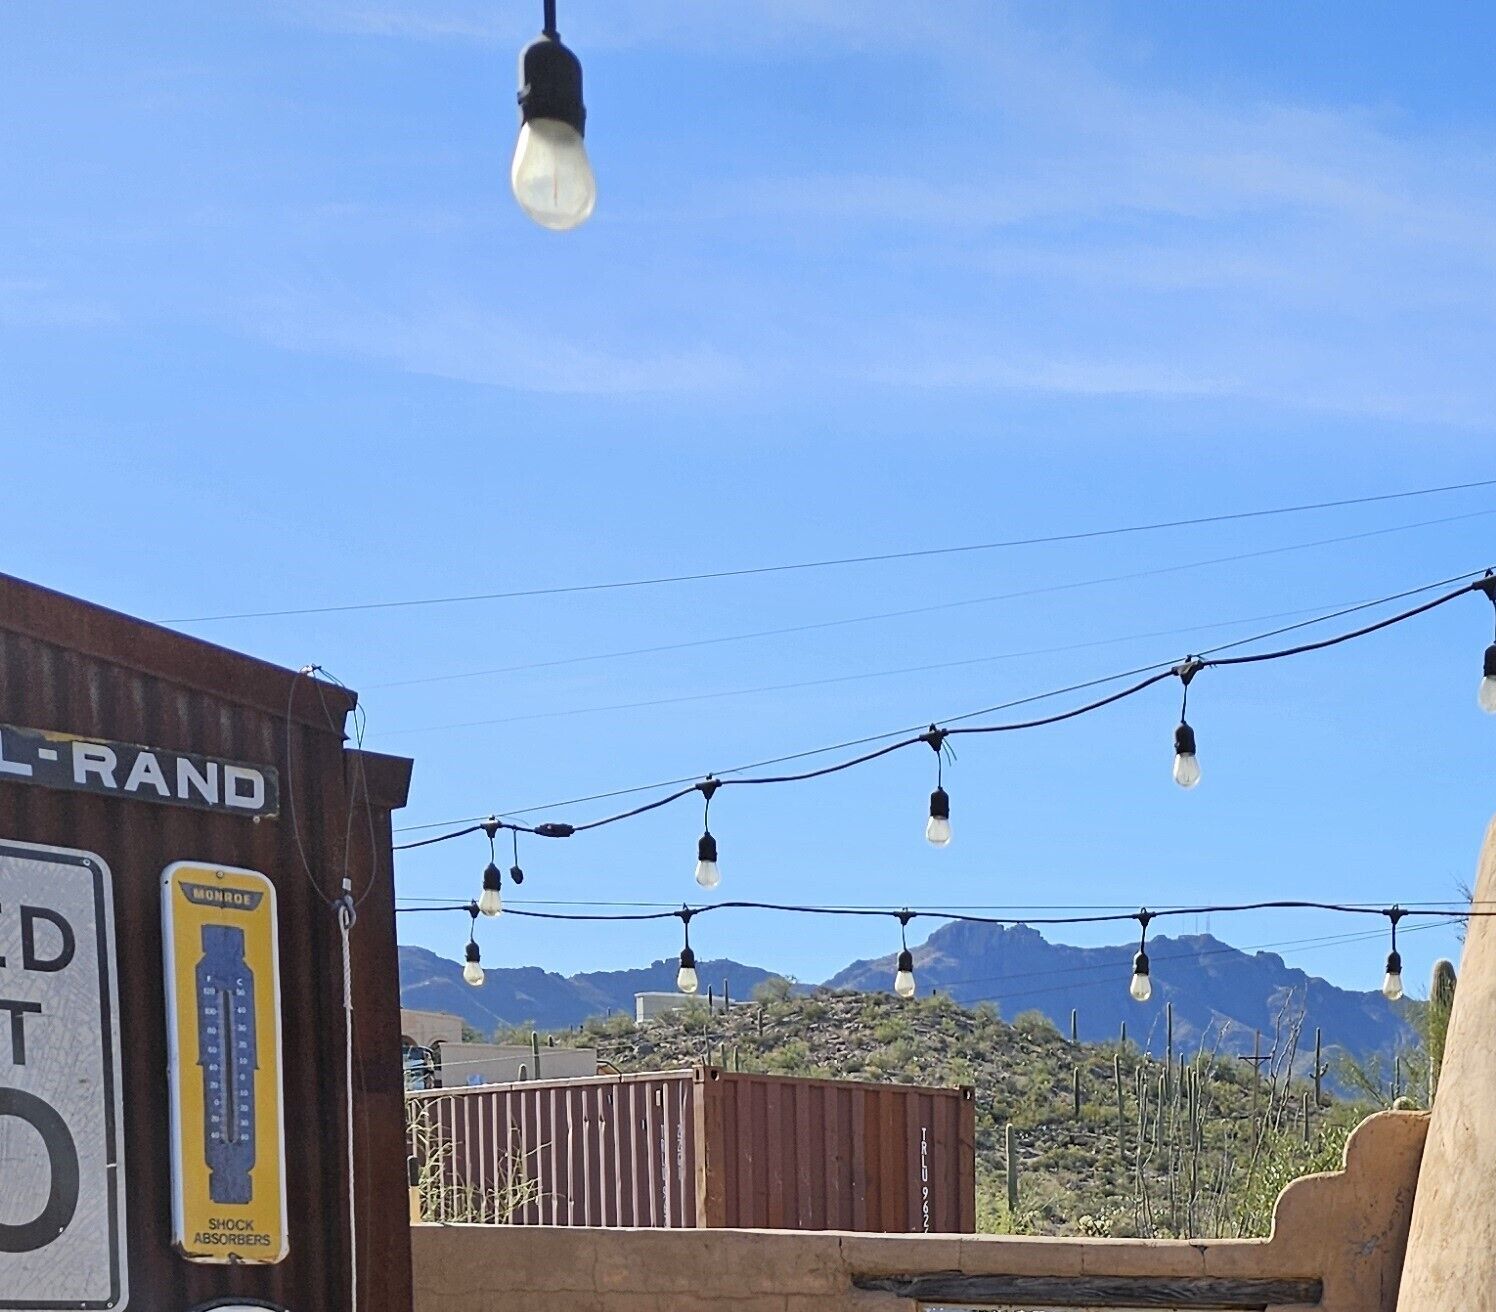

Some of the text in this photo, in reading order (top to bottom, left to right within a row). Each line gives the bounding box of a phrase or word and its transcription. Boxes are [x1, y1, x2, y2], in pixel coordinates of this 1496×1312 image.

[193, 887, 252, 905] MONROE
[0, 904, 75, 973] D
[921, 1127, 929, 1182] TRLU
[208, 1218, 255, 1232] SHOCK
[193, 1231, 272, 1247] ABSORBERS
